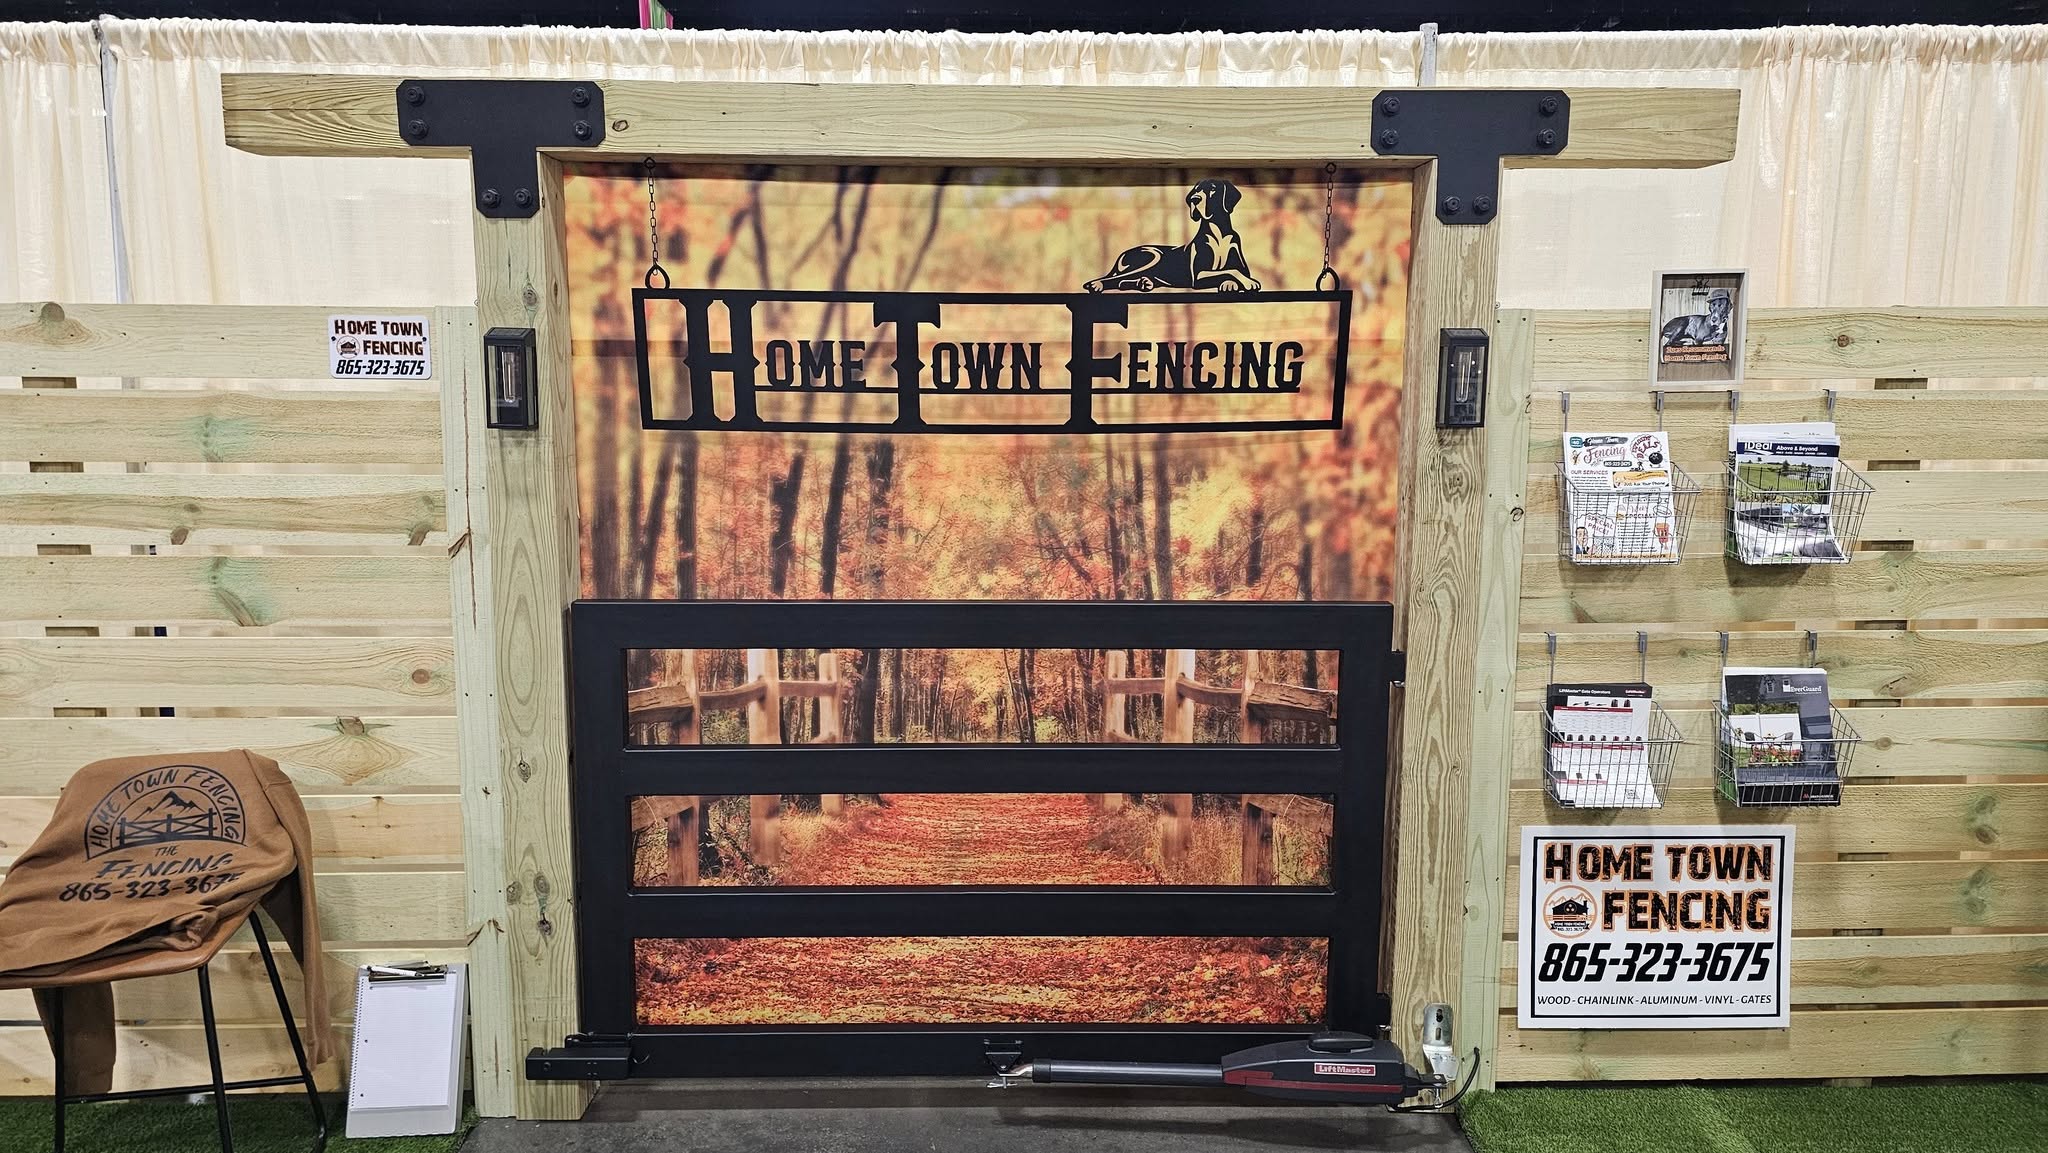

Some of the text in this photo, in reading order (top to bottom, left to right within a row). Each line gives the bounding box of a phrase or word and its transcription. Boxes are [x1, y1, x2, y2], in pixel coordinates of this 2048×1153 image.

[334, 319, 423, 336] HOME TOWN
[363, 340, 424, 356] FENCING
[336, 359, 425, 375] 865-323-3675
[682, 291, 1304, 430] HOME TOWN FENCING
[1583, 446, 1627, 464] Fencing
[91, 769, 241, 849] HOME TOWN FENCING
[155, 845, 180, 857] THE
[1544, 842, 1774, 883] HOME TOWN
[1600, 889, 1772, 933] FENCING
[1538, 942, 1775, 982] 865-323-3675
[1537, 995, 1772, 1005] WOOD CHAINLINK ALUMINUM VINYL GATES
[1319, 1064, 1371, 1074] LiftMaster
